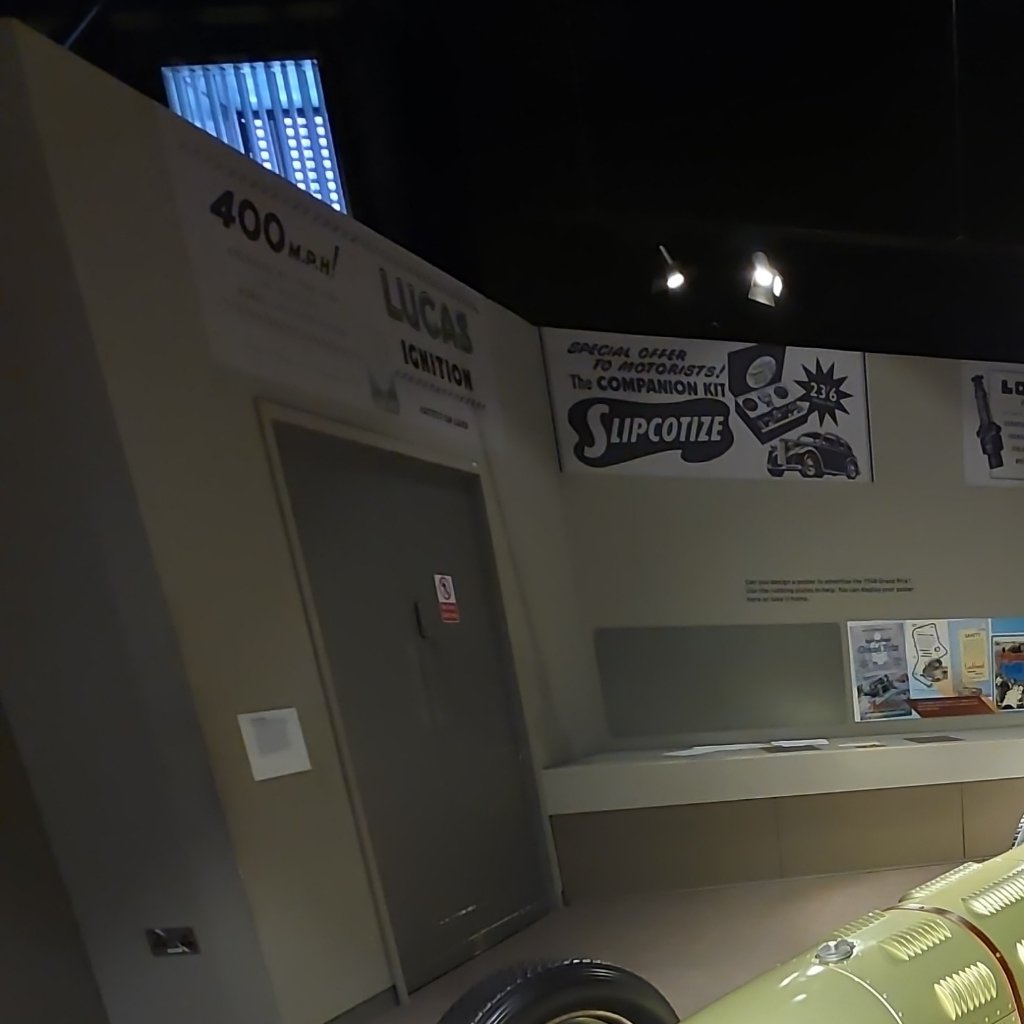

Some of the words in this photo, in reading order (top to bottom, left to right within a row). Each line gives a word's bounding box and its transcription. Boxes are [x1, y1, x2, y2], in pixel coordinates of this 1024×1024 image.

[209, 190, 285, 253] 400
[379, 267, 473, 354] LUCAS
[401, 339, 473, 391] IGNITION
[567, 341, 630, 359] SPECIAL
[638, 347, 687, 361] OFFER
[593, 358, 613, 372] TO
[618, 360, 726, 379] MOTORISTS!
[570, 374, 592, 390] The
[597, 375, 698, 396] COMPANION
[703, 382, 726, 398] KIT
[583, 403, 724, 459] SLIPCOTIZE
